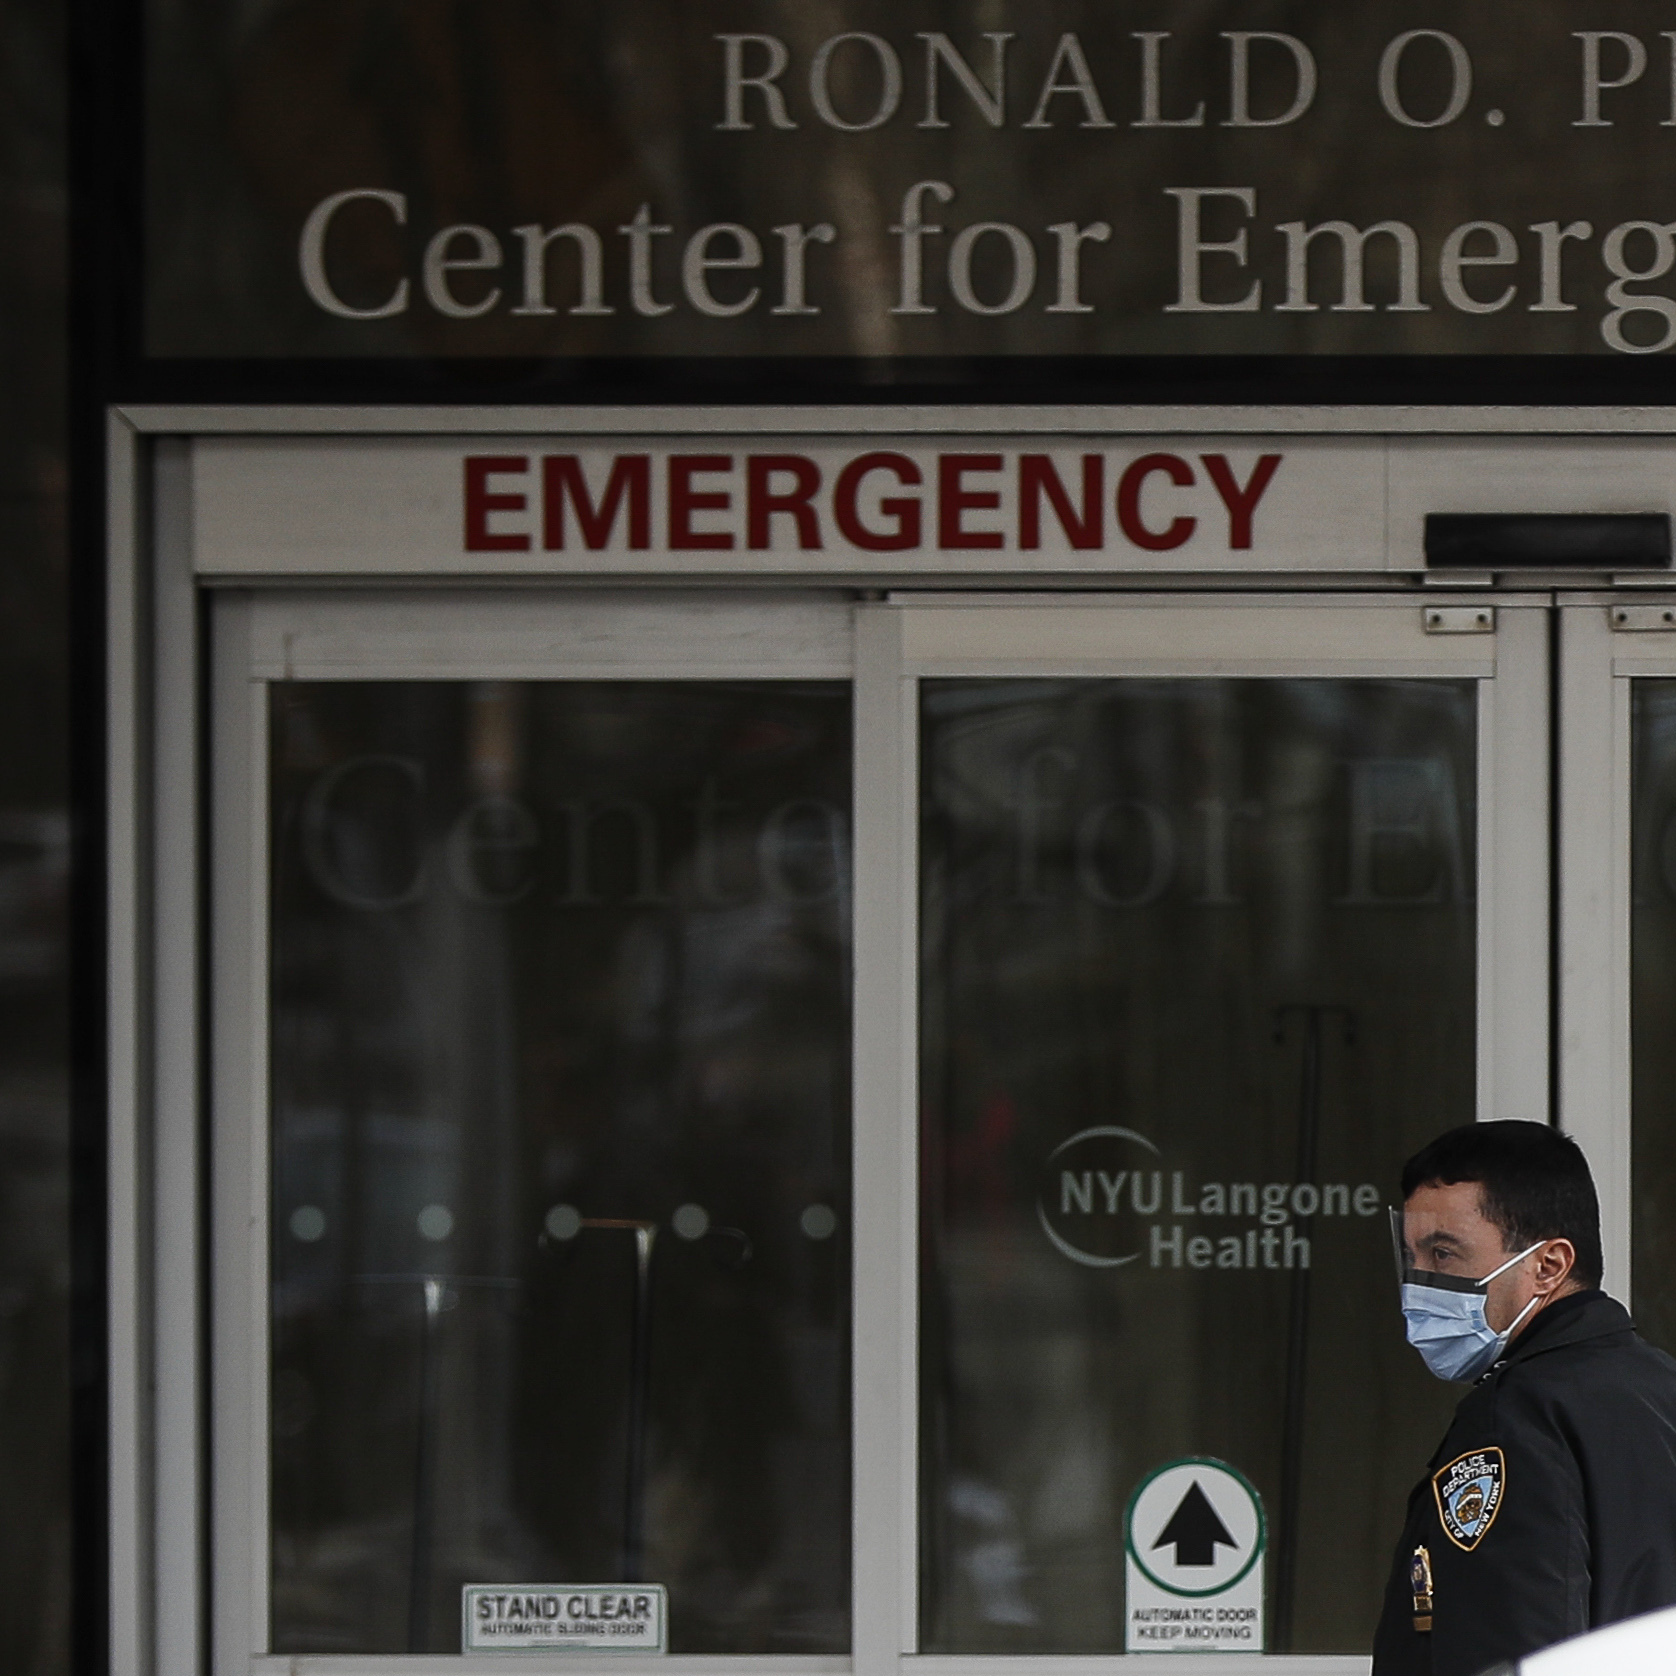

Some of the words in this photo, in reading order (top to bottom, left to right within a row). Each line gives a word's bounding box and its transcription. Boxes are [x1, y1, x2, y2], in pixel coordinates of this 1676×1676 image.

[715, 31, 1320, 130] RONALD
[1378, 28, 1507, 129] O.
[297, 187, 835, 319] Center
[888, 181, 1110, 316] for
[463, 452, 1284, 552] EMERGENCY
[1060, 1170, 1162, 1215] NYU
[1171, 1170, 1381, 1226] Langone
[1151, 1225, 1312, 1269] Health
[1441, 1463, 1500, 1499] DEPARTMENT
[1451, 1454, 1486, 1478] POLICE
[1474, 1512, 1491, 1538] NEW
[1485, 1480, 1501, 1512] YORK
[476, 1595, 560, 1620] STAND
[566, 1594, 651, 1620] CLEAR
[1132, 1607, 1213, 1623] AUTOMATIC
[1216, 1607, 1259, 1622] DOOR
[1138, 1625, 1183, 1641] KEEP
[1184, 1625, 1252, 1641] MOVING
